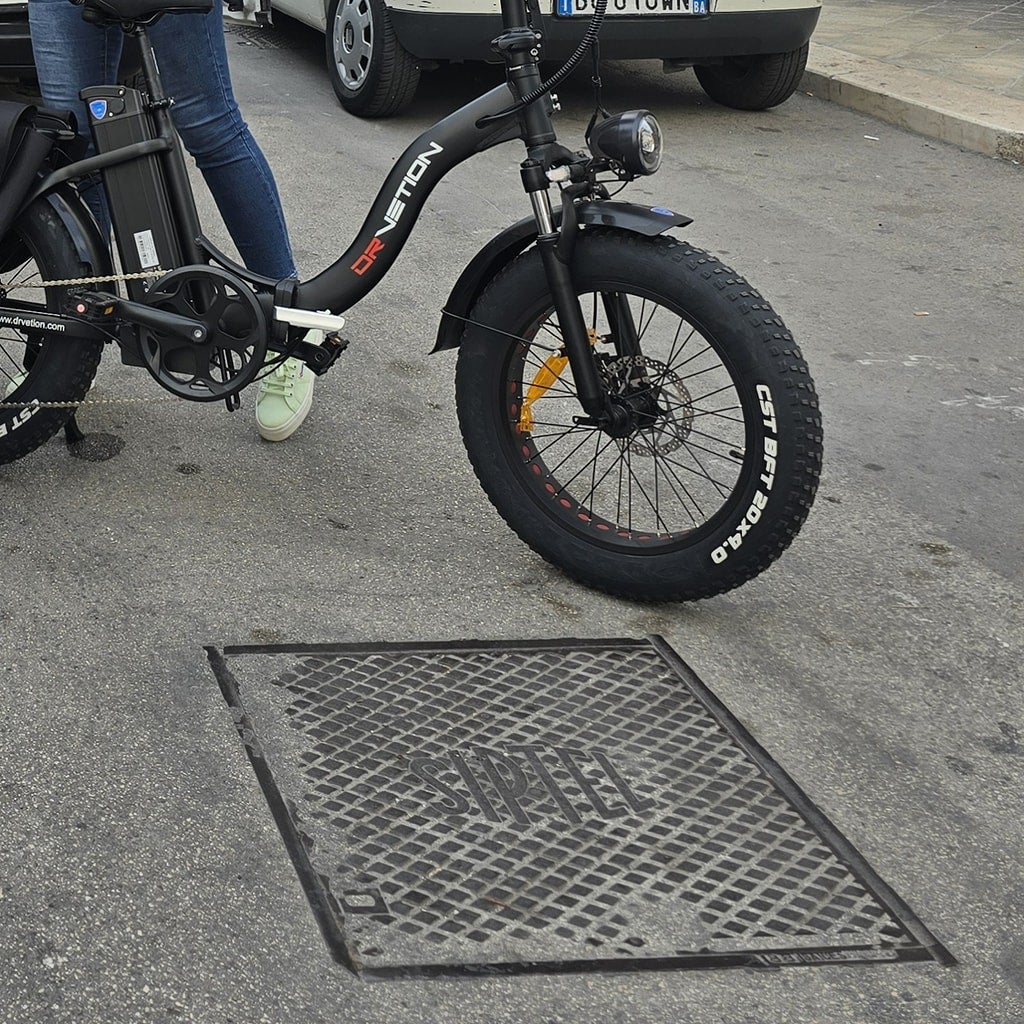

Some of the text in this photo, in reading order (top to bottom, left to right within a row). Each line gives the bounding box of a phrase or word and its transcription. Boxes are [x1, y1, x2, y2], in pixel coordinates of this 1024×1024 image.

[756, 384, 778, 434] CST
[759, 436, 778, 491] BFT
[408, 744, 659, 826] SIPTEL
